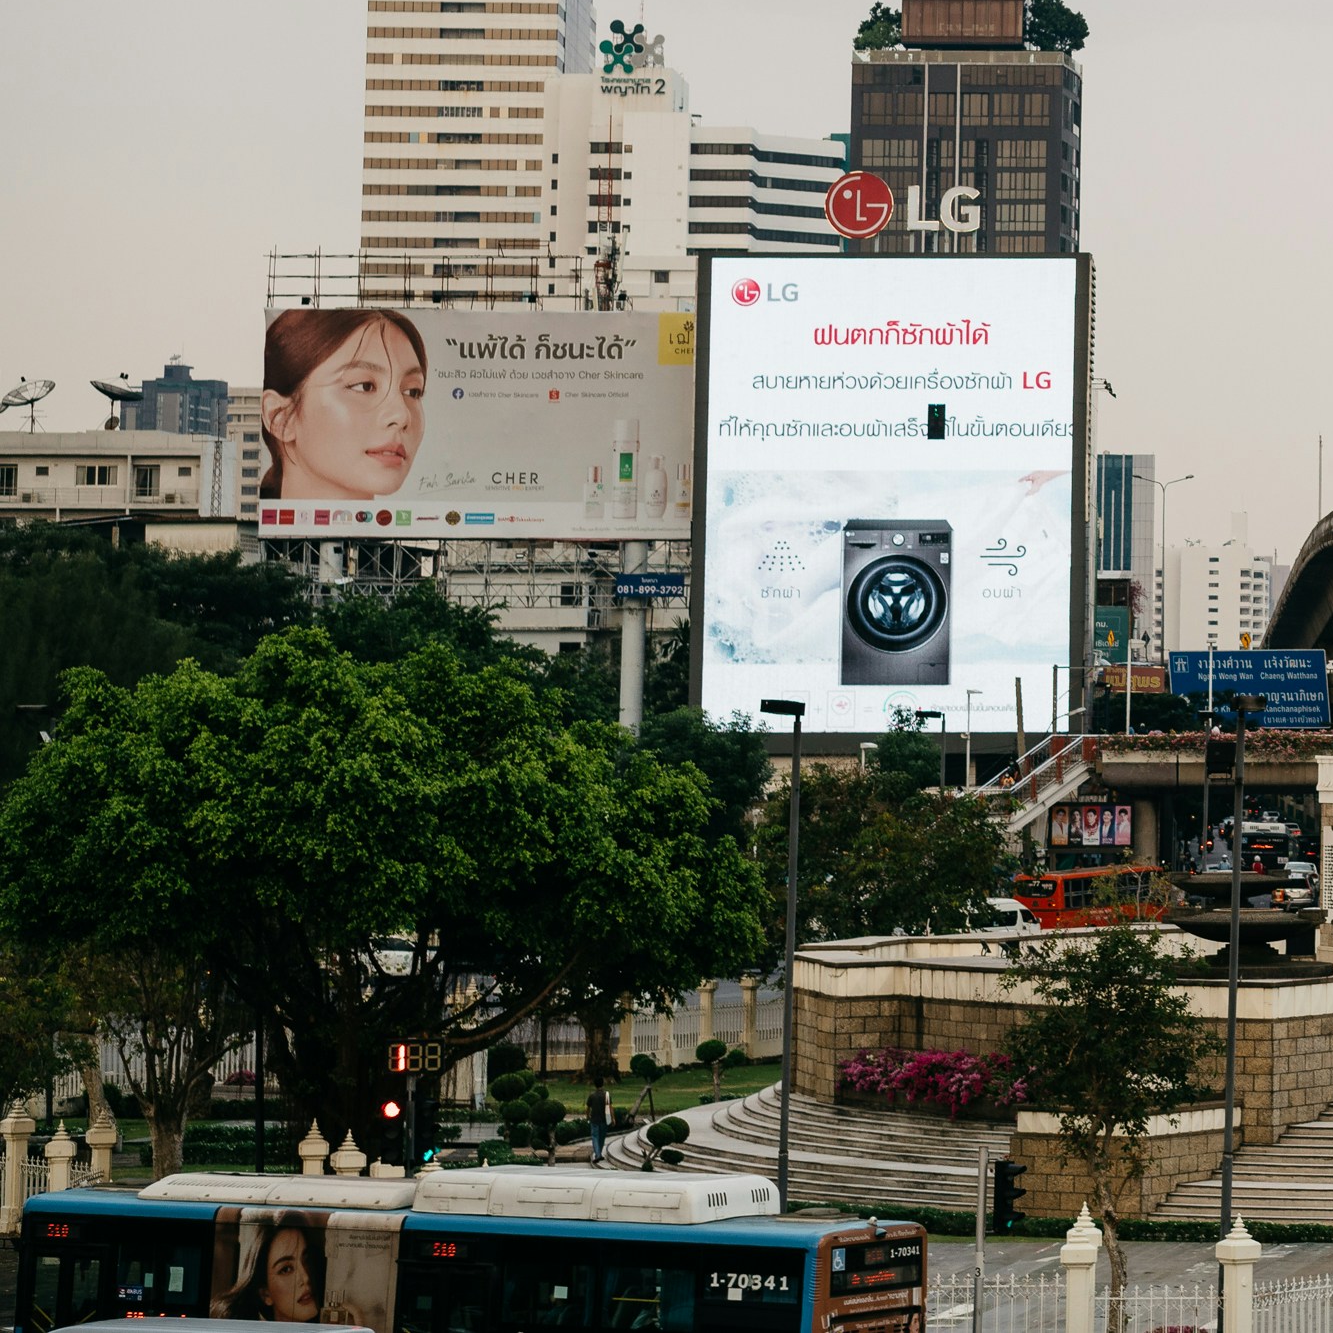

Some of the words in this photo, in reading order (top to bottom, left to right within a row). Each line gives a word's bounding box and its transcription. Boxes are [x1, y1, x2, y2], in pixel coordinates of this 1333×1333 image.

[600, 82, 651, 96] พญาไท
[655, 78, 666, 95] 2
[907, 185, 981, 233] LG
[767, 283, 799, 302] LG
[669, 330, 694, 345] เฌ
[813, 320, 991, 346] ฝนตกก็ซักผ้าได้
[510, 369, 528, 379] ด้วย
[578, 370, 601, 380] Cher
[603, 370, 644, 380] Skincare
[752, 368, 1012, 390] สบายหายห่วงด้วยเครื่องซักผ้า
[1022, 371, 1052, 390] LG
[491, 471, 539, 485] CHER
[617, 585, 683, 594] 081-899-3792
[761, 585, 801, 599] ซักผ้า
[982, 585, 1022, 599] อบผ้า
[1264, 655, 1312, 669] แจ้งวัฒนะ
[1219, 672, 1238, 682] Wong
[1239, 672, 1254, 680] Wan
[1260, 672, 1285, 682] Chaeng
[1287, 672, 1318, 680] Watthana
[890, 1245, 920, 1259] 1-70341
[710, 1271, 789, 1291] 1-70341
